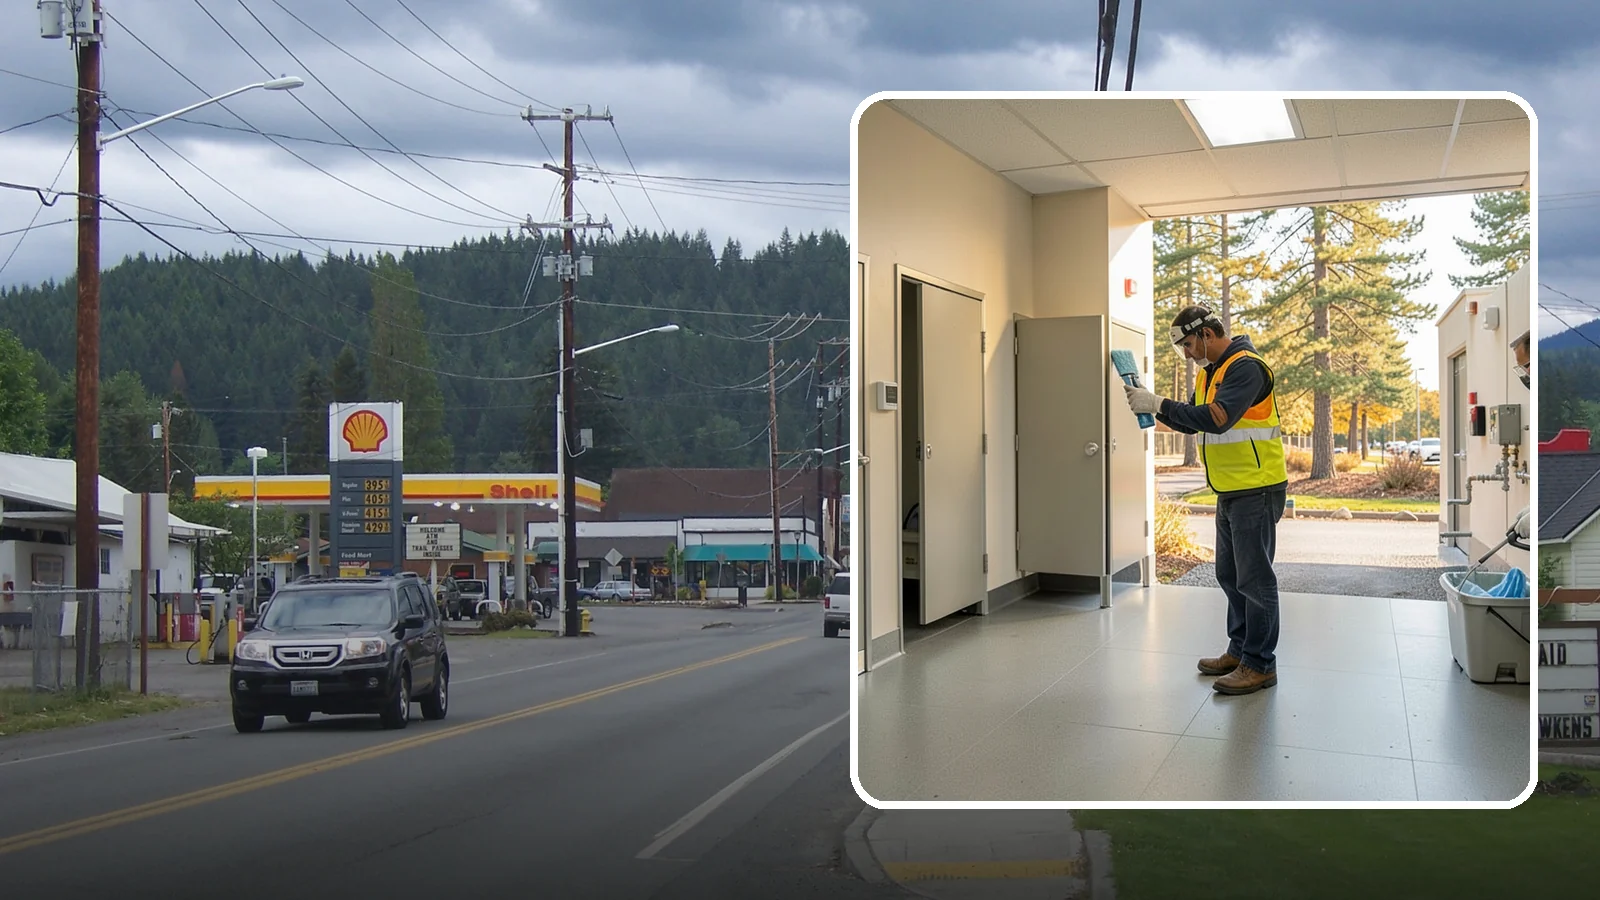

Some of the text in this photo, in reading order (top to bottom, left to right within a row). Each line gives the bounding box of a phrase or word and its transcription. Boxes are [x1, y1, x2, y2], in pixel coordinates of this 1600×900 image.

[366, 480, 383, 490] 395
[490, 484, 547, 499] Shell
[366, 494, 383, 504] 405
[366, 508, 383, 518] 415
[366, 522, 383, 532] 429
